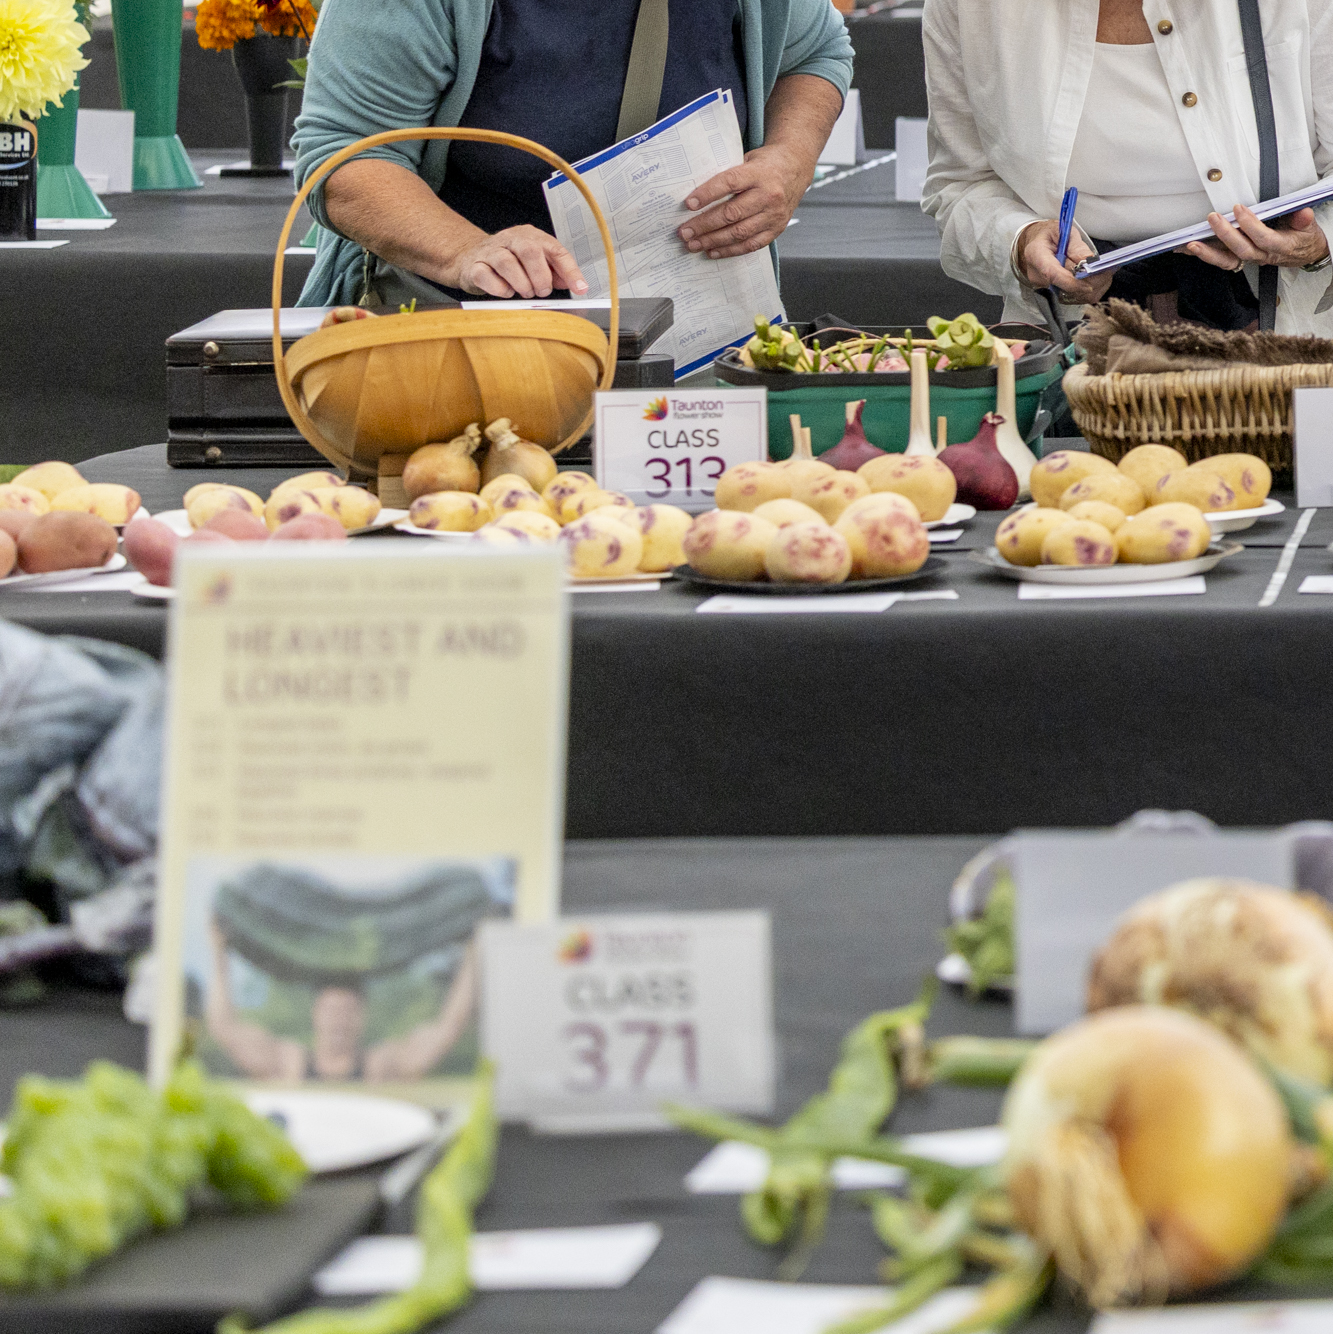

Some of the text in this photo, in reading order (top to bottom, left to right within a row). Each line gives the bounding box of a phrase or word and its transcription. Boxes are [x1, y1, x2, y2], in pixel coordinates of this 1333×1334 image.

[632, 162, 660, 182] AVERY
[680, 327, 707, 346] AVERY
[671, 399, 723, 411] Taunton
[647, 429, 720, 449] CLASS
[644, 456, 726, 499] 313
[224, 619, 527, 661] HEAVIEST AND
[222, 666, 413, 707] LONGEST
[564, 970, 698, 1013] CLASS
[561, 1020, 698, 1094] 371
